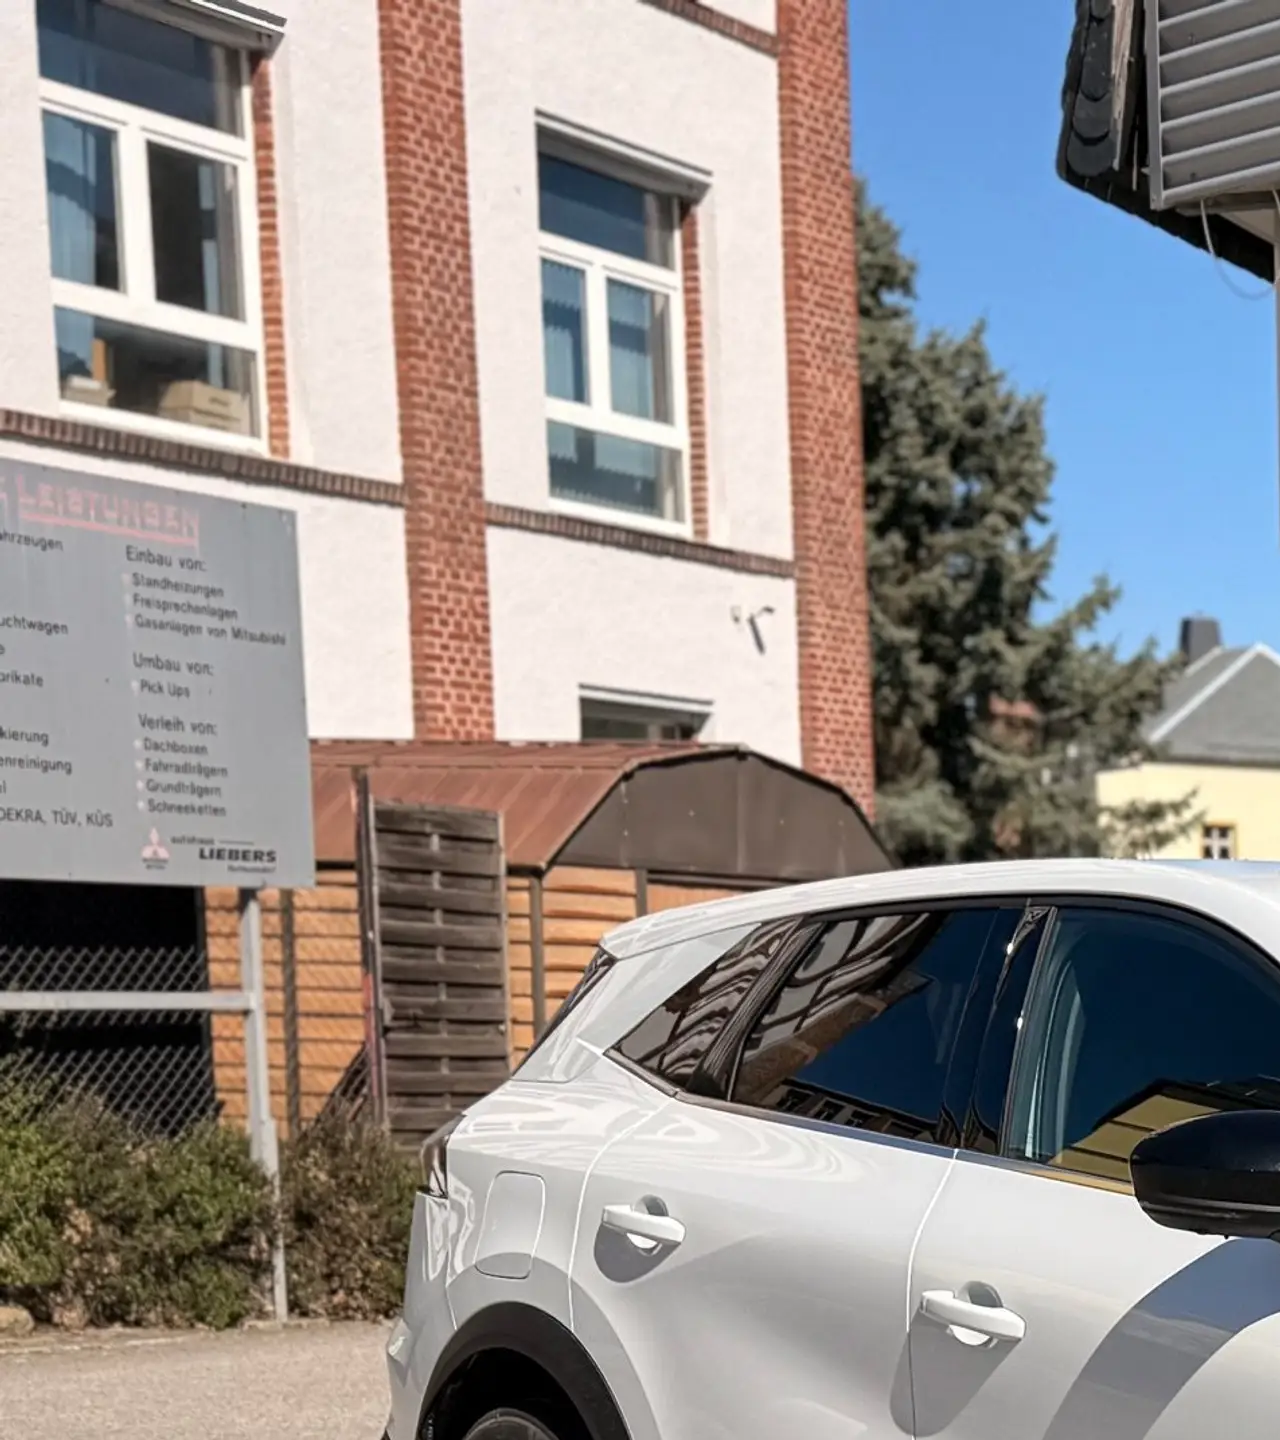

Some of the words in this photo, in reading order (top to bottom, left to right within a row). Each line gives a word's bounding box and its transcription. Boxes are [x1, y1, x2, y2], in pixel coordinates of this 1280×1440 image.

[126, 544, 172, 567] Einbau
[132, 572, 224, 598] Standheizungen
[133, 593, 238, 620] Freisprechanlagen
[134, 613, 202, 636] Gasanlagen
[207, 626, 227, 638] von
[231, 626, 286, 646] Mitsubishi
[132, 652, 181, 672] Umbau
[140, 679, 163, 694] Pick
[168, 682, 190, 698] Ups
[138, 713, 185, 732] Verleih
[144, 737, 208, 755] Dachboxen
[86, 808, 113, 827] KÜS
[199, 847, 277, 862] LIEBERS
